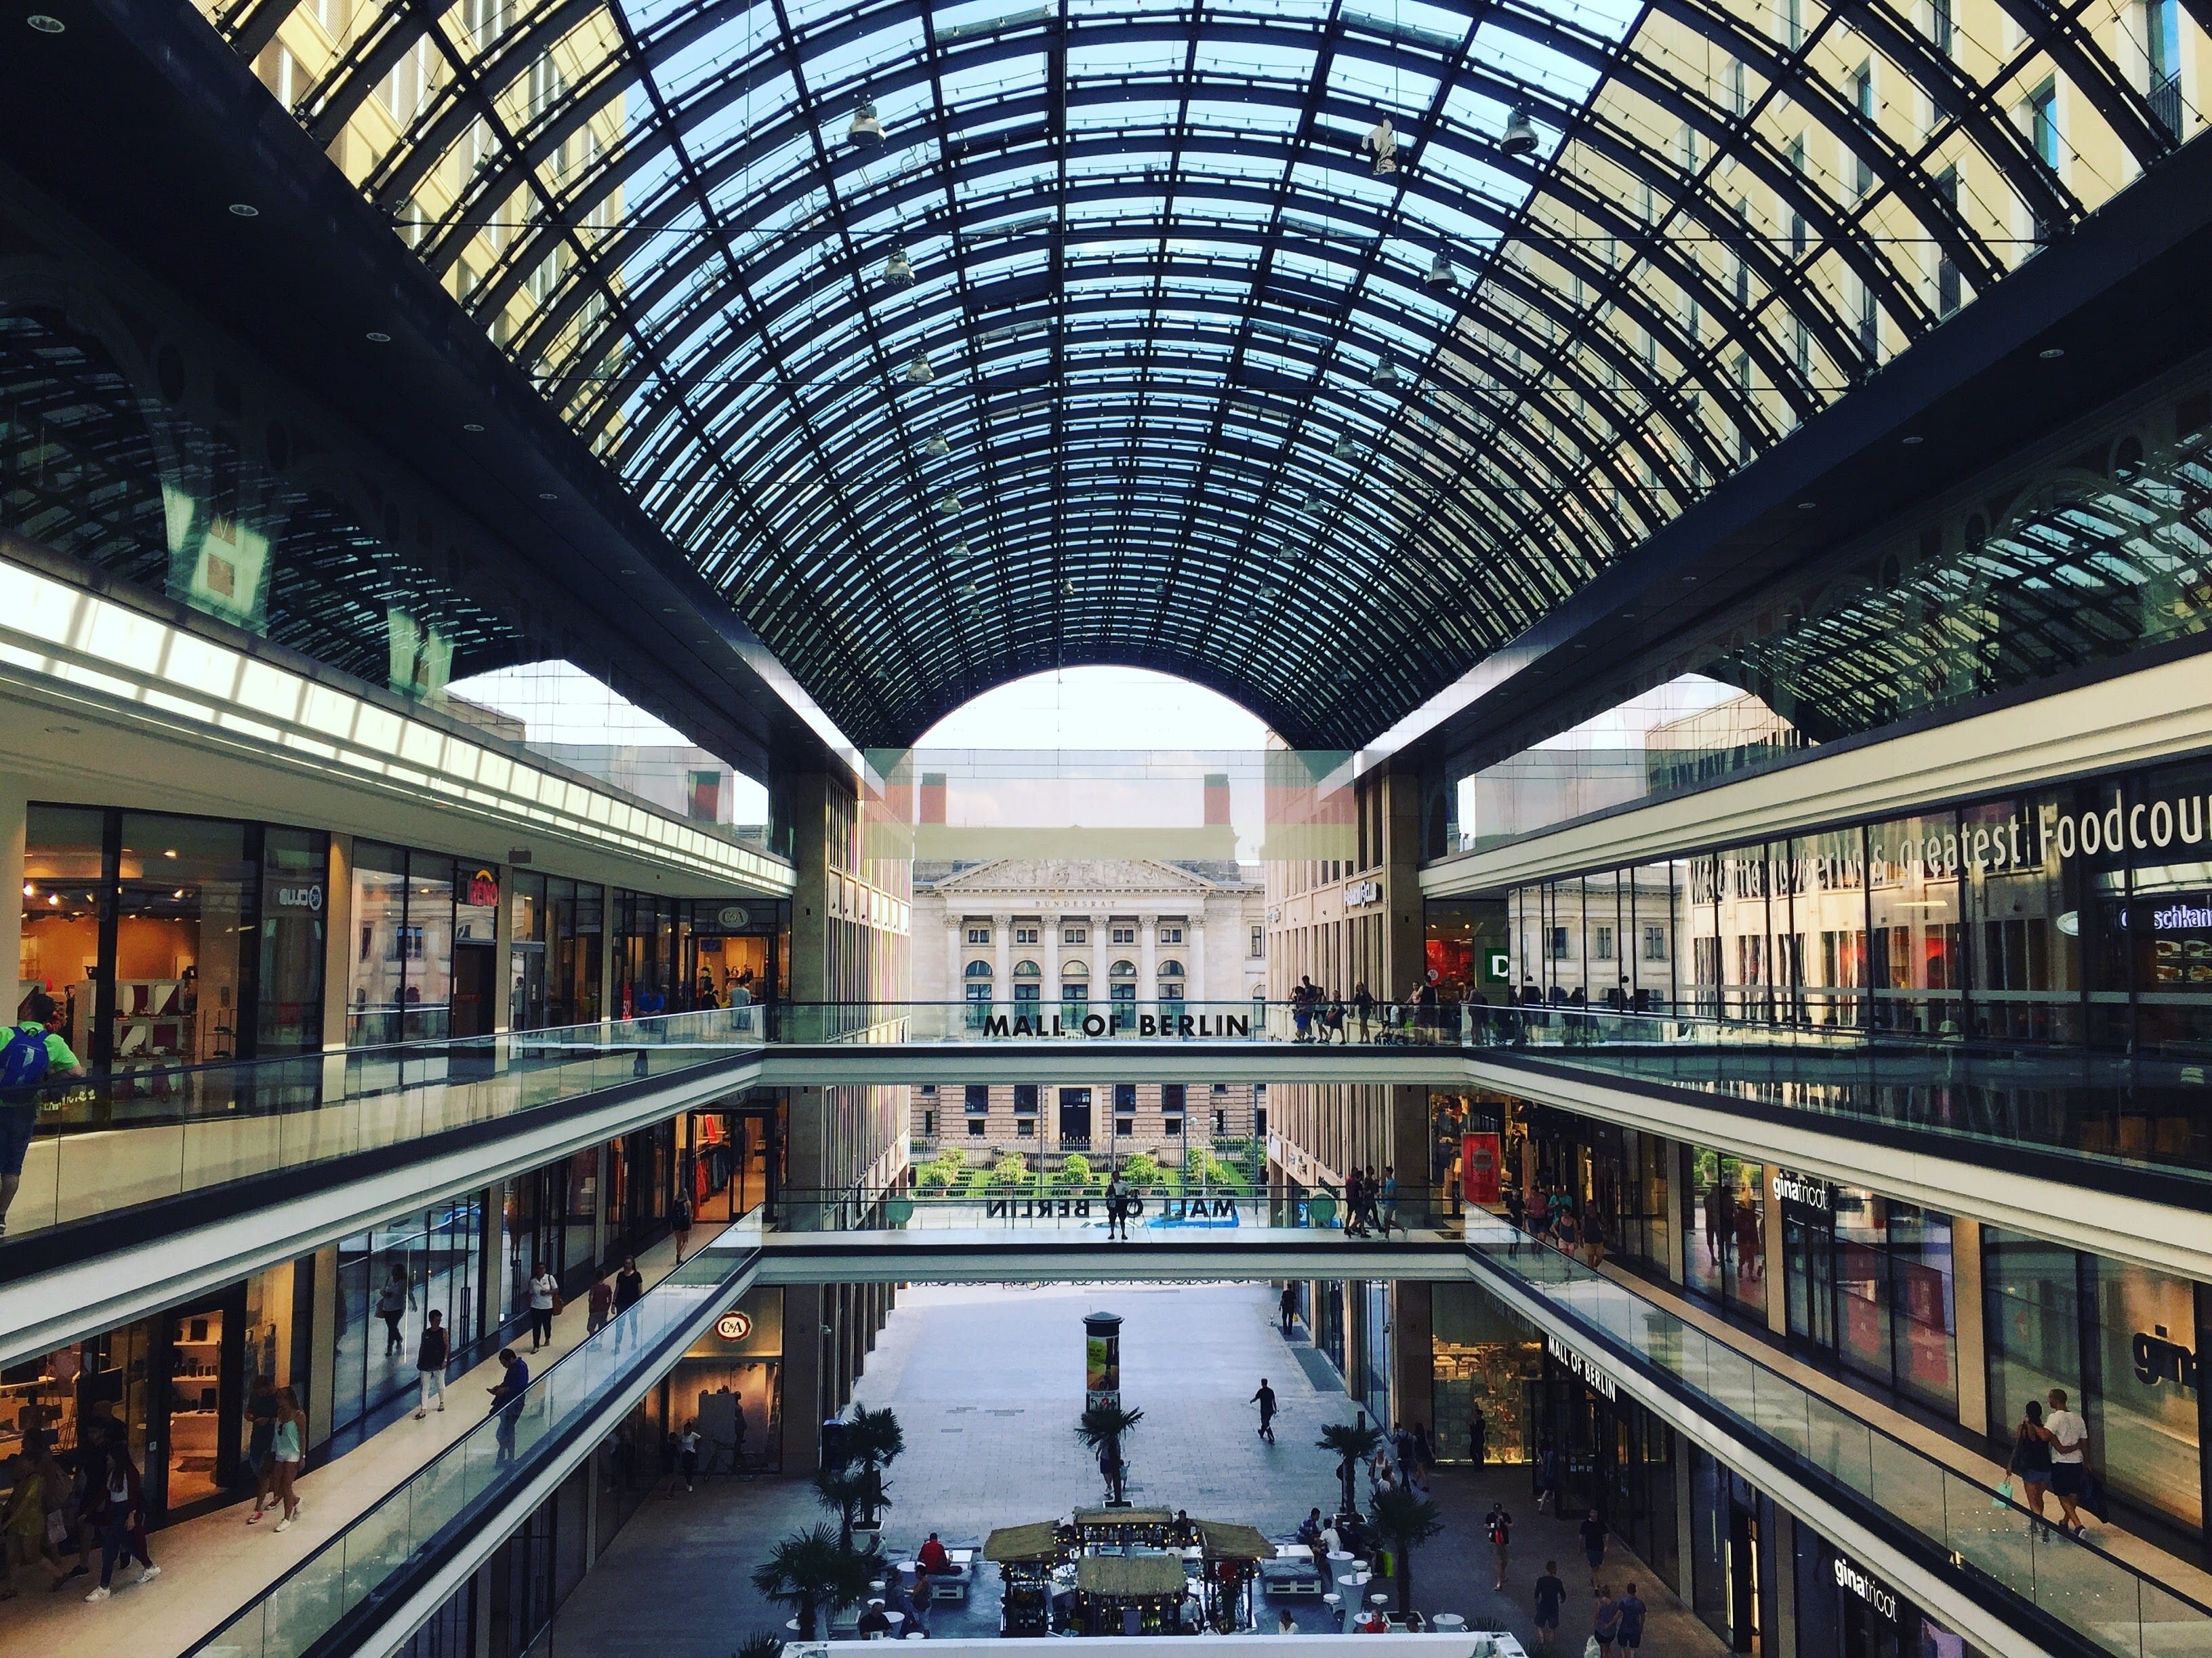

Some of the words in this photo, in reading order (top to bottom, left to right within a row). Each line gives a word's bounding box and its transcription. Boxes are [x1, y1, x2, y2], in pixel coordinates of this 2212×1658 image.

[1899, 814, 2022, 886] greatest
[982, 1014, 1067, 1037] MALL
[1082, 1013, 1122, 1037] OF
[1140, 1014, 1248, 1037] BERLIN
[1772, 1172, 1827, 1211] ginatricot
[720, 1321, 743, 1333] C&A
[1548, 1335, 1569, 1367] MALL
[1570, 1352, 1582, 1376] OF
[1584, 1362, 1616, 1403] BERLIN
[1834, 1558, 1898, 1623] ginatricot
